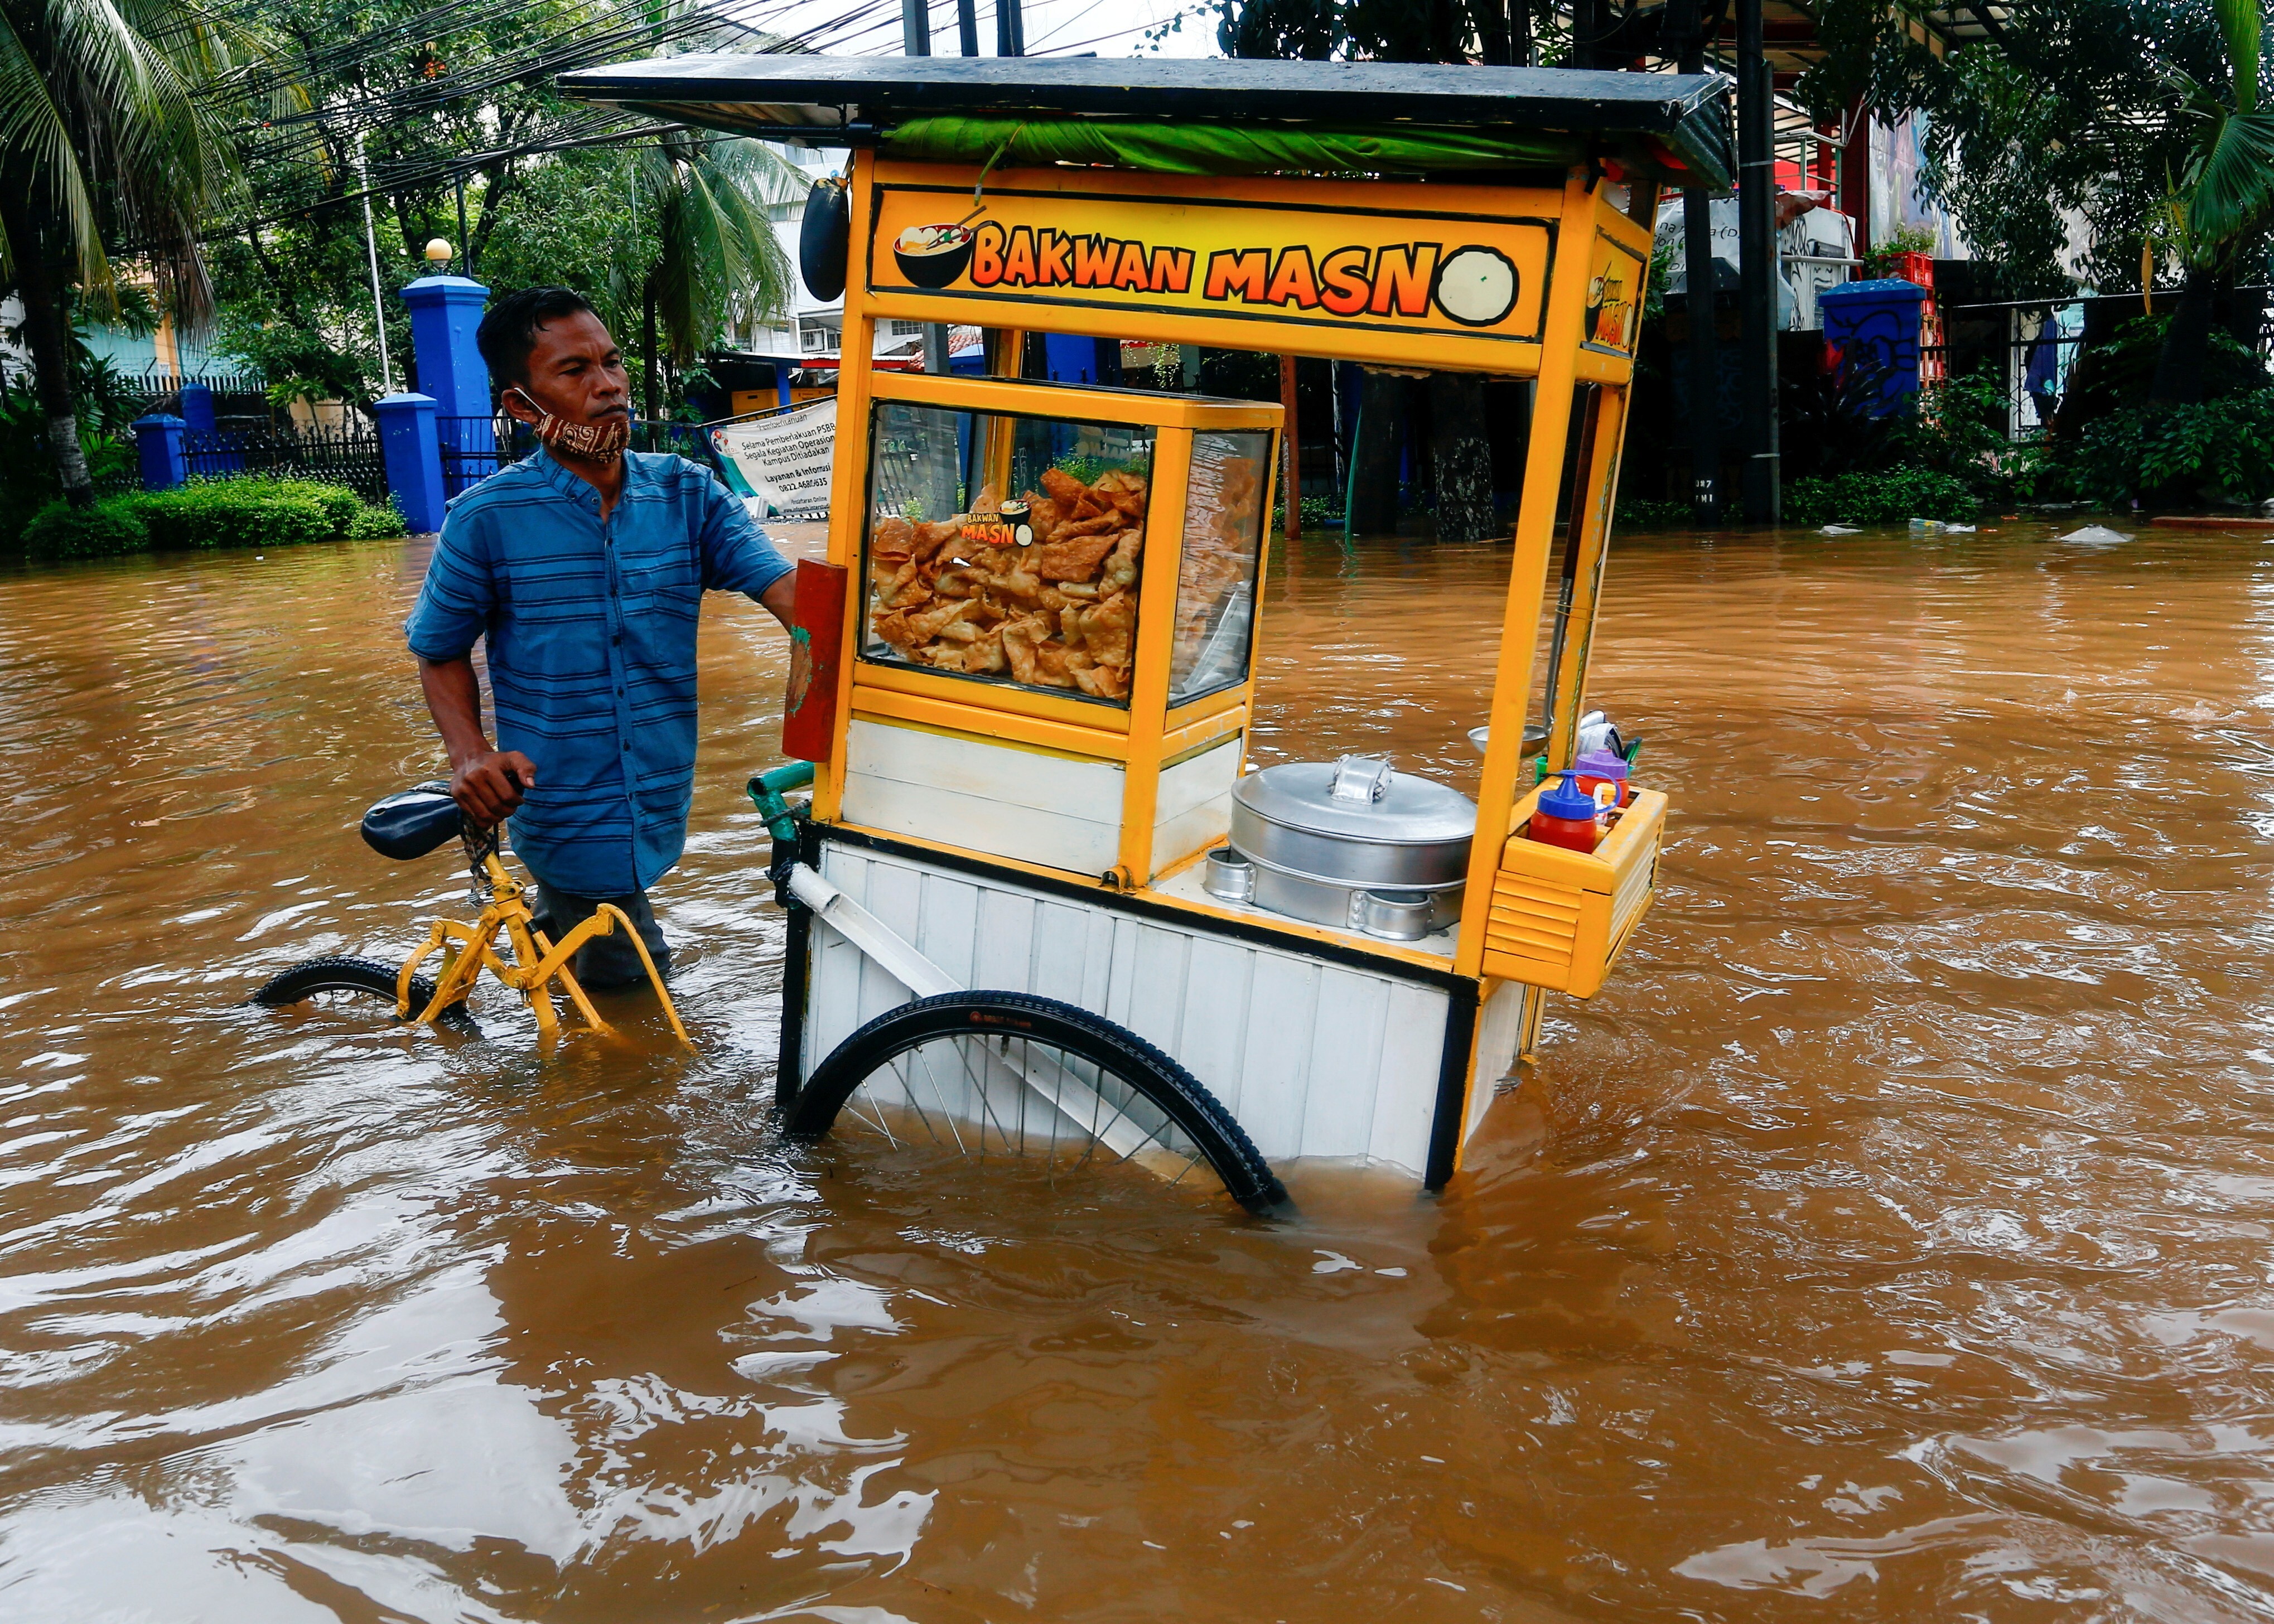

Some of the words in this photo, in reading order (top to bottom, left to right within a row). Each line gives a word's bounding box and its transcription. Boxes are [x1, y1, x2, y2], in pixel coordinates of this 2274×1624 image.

[969, 220, 1196, 294] BAKWAN
[1203, 241, 1520, 327] MASNO
[742, 441, 765, 451] Selama
[765, 428, 817, 446] Pemberlakuan
[817, 423, 836, 434] PSBB
[744, 450, 766, 461] Segala
[767, 444, 798, 456] Kegiatan
[798, 435, 834, 450] Operasion
[762, 456, 790, 466] Kampus
[790, 447, 829, 461] Ditiadakan
[765, 472, 795, 483] Layanan
[803, 462, 831, 475] Informasi
[967, 513, 999, 524] BAKWAN
[961, 523, 1034, 547] MASNO
